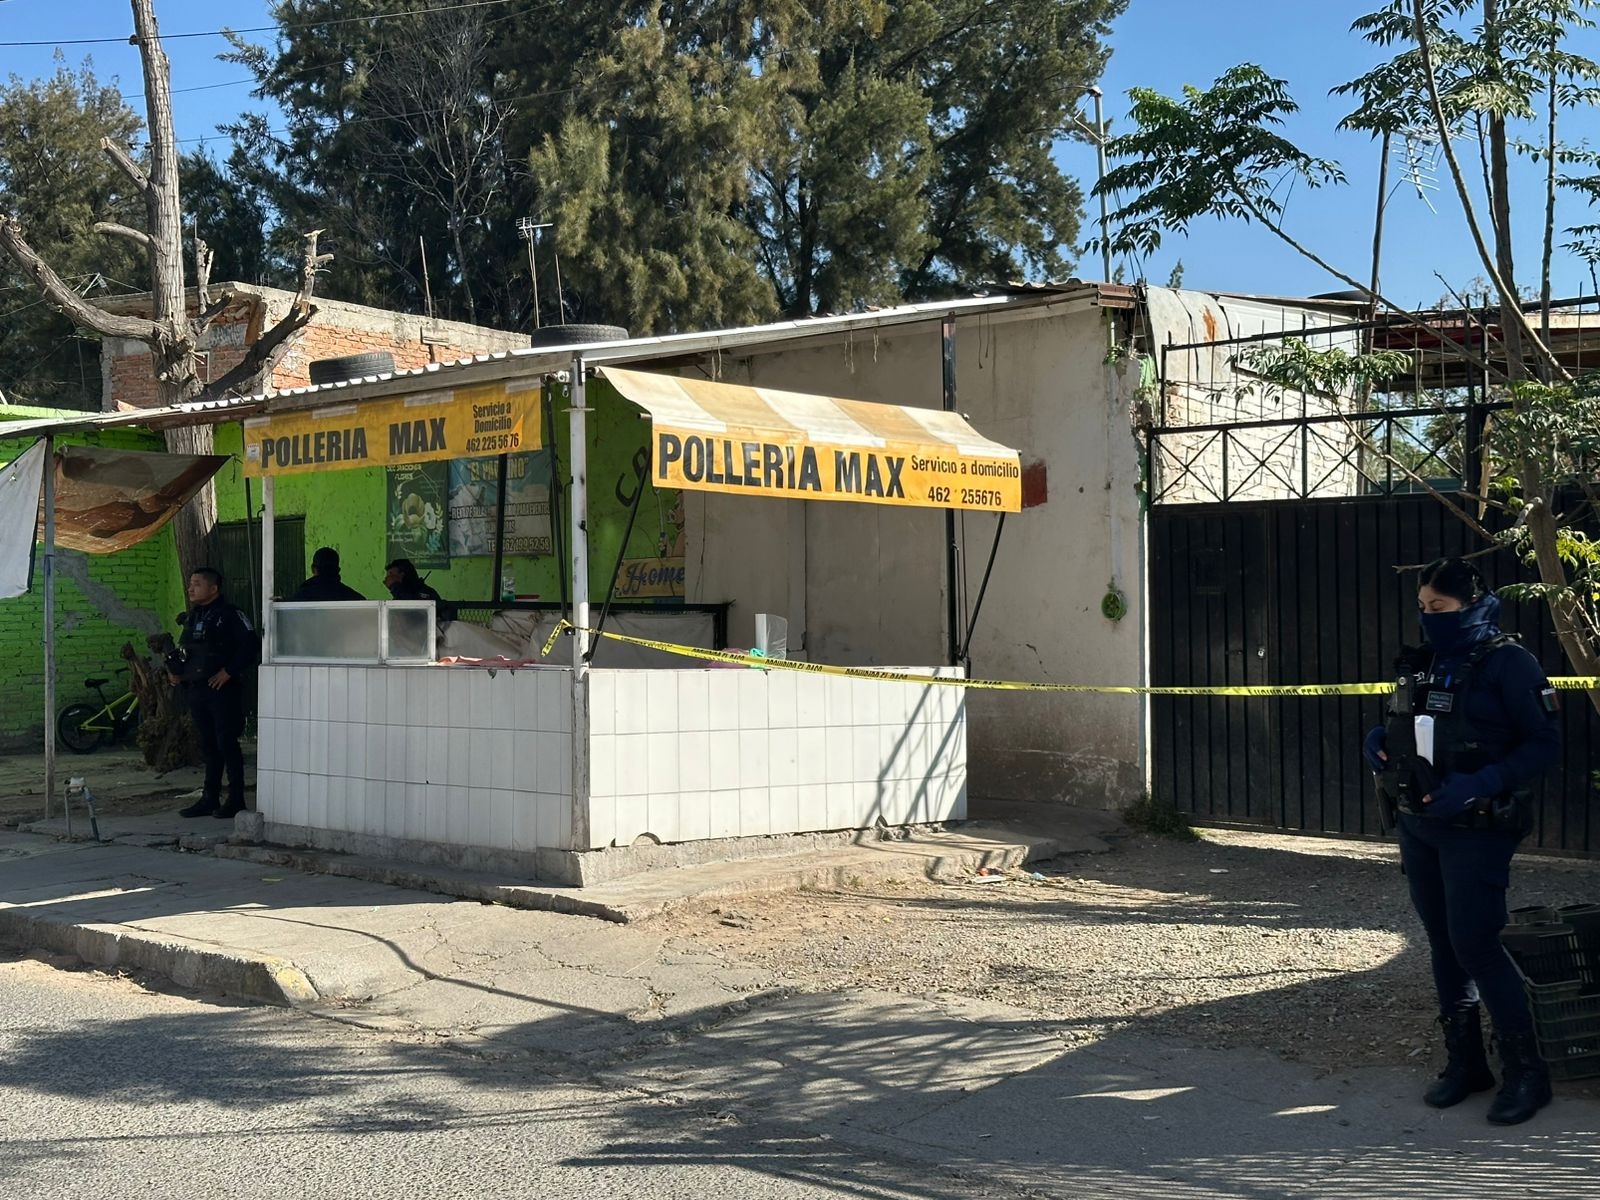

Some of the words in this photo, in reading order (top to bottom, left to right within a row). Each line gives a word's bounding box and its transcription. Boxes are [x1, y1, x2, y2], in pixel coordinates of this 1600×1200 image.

[473, 401, 505, 418] Servicio
[506, 402, 511, 414] a
[474, 416, 512, 433] Domicilio
[261, 427, 368, 468] POLLERIA
[389, 417, 446, 456] MAX
[466, 438, 480, 453] 462
[482, 436, 496, 451] 225
[498, 434, 508, 449] 56
[510, 432, 519, 448] 76
[658, 433, 822, 492] POLLERIA
[834, 450, 905, 499] MAX
[911, 454, 957, 475] Servicio
[960, 462, 967, 474] a
[970, 459, 1019, 479] domicilio
[928, 486, 951, 503] 462
[961, 487, 1002, 506] 255676
